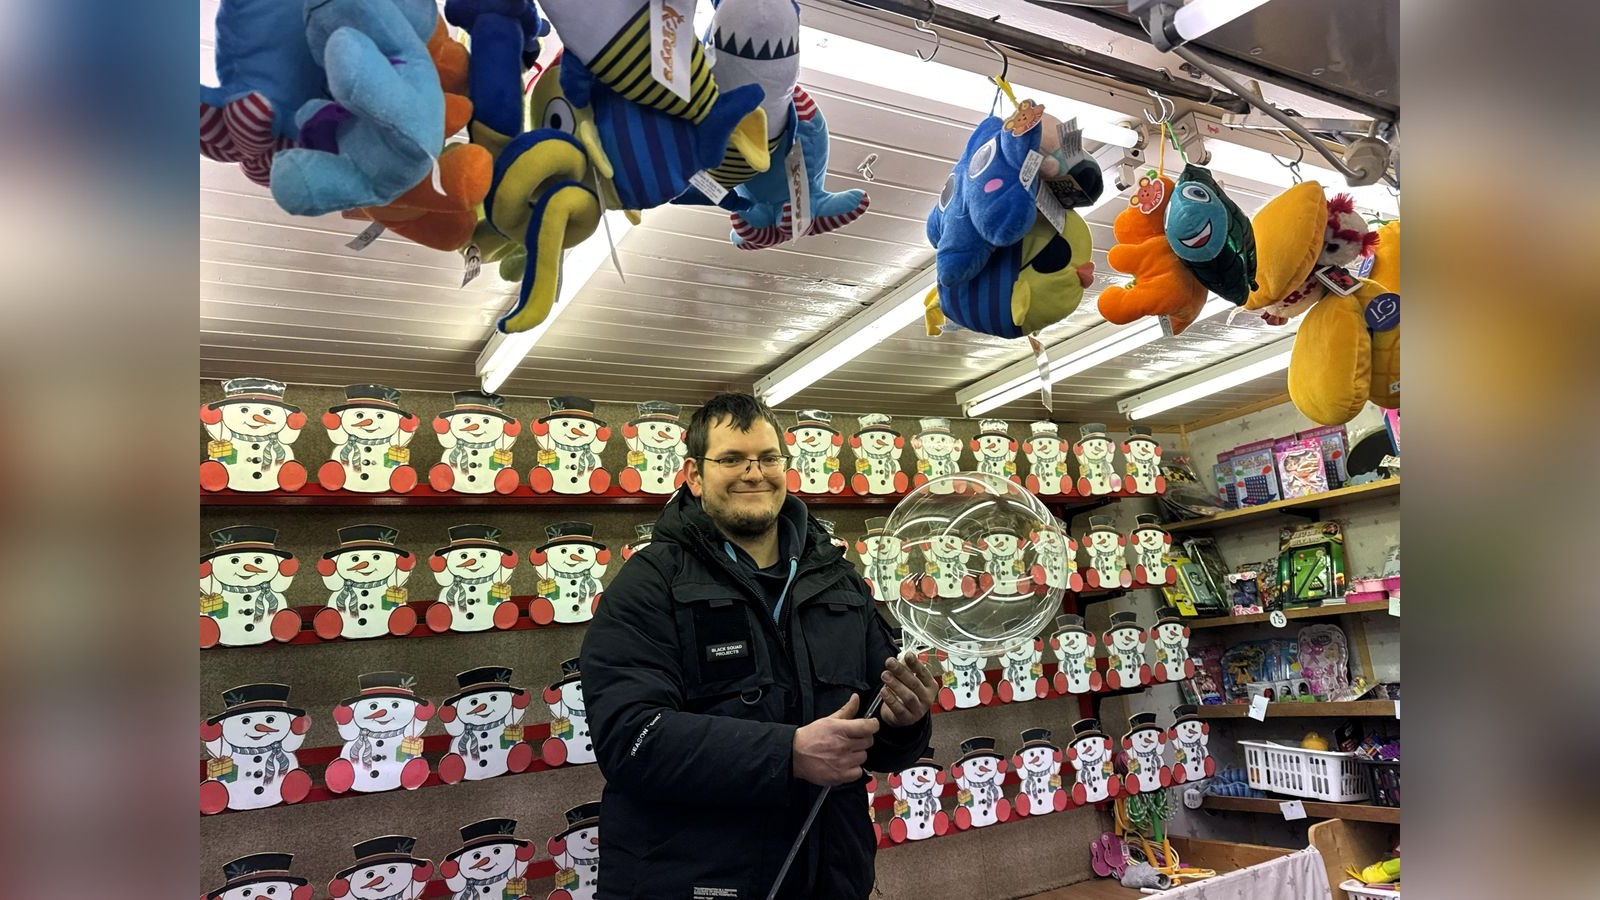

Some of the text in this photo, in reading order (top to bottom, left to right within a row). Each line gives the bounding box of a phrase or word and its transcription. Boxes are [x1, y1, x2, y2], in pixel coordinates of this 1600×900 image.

[1272, 615, 1284, 625] 15
[715, 649, 739, 657] PROJECTS
[630, 728, 649, 757] SEASON
